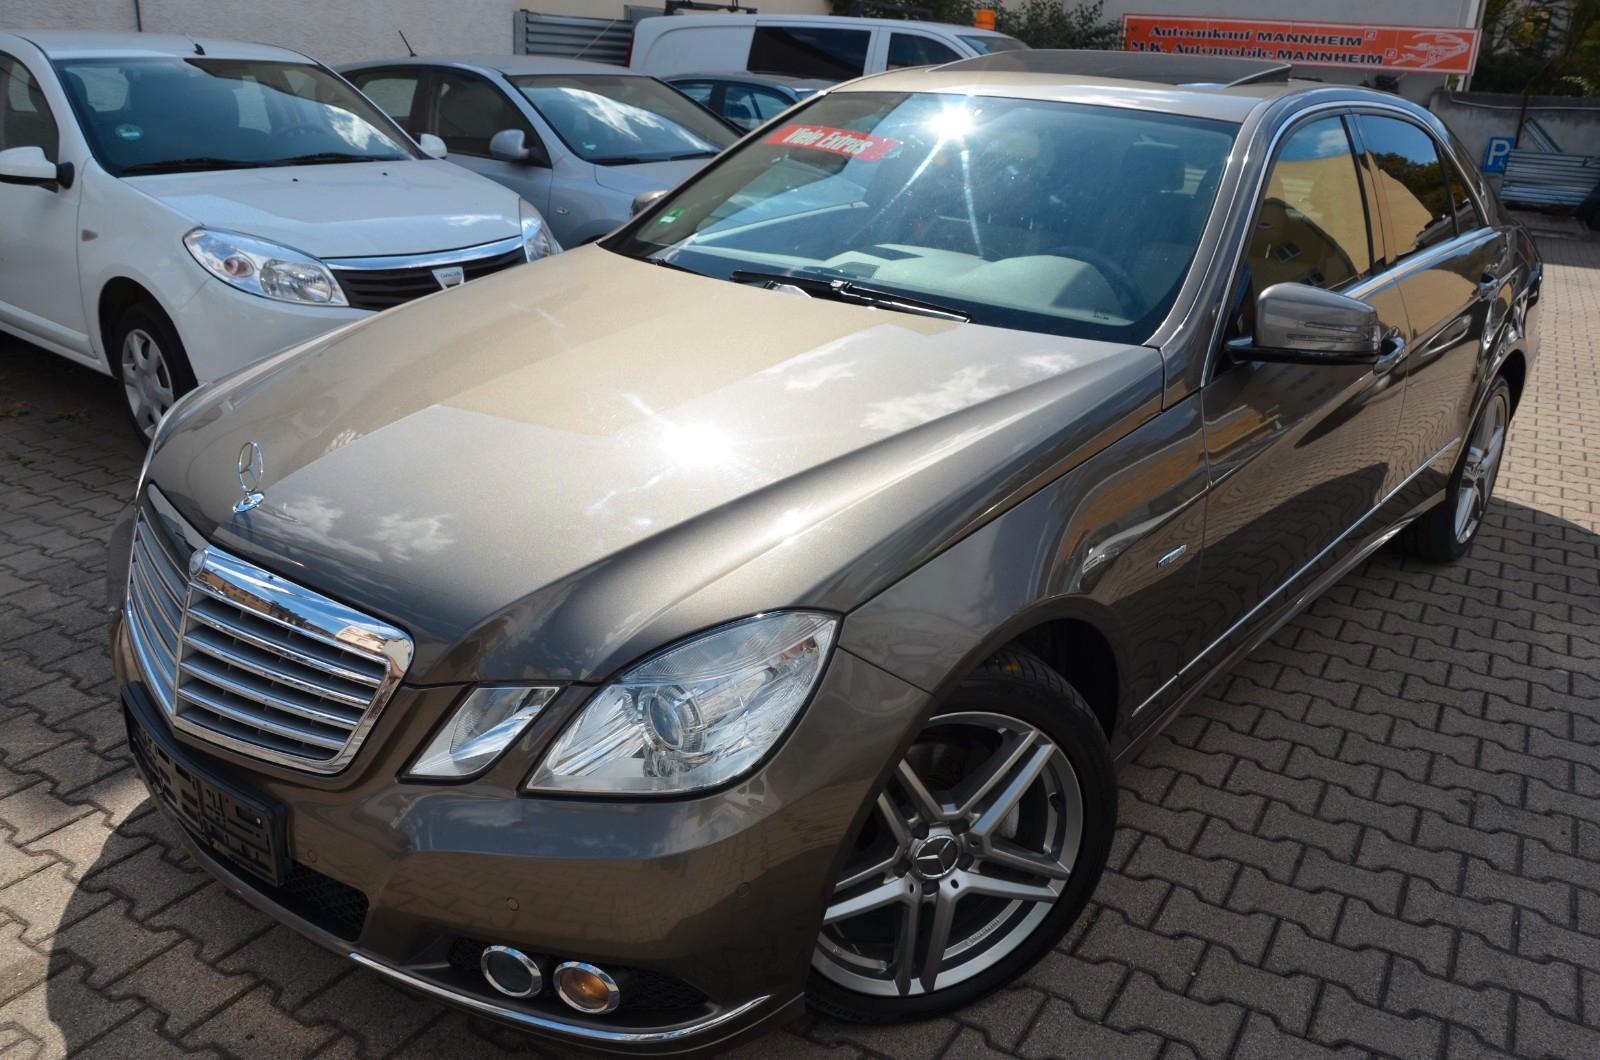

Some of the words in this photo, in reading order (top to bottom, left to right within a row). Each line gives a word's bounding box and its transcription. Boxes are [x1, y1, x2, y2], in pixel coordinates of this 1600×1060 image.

[1151, 26, 1252, 41] Autoankauf
[1257, 31, 1364, 46] MANNHEIM
[1174, 43, 1273, 59] Automobile
[1277, 50, 1384, 64] MANNHEIM
[815, 132, 874, 155] Extras
[1487, 139, 1510, 166] P
